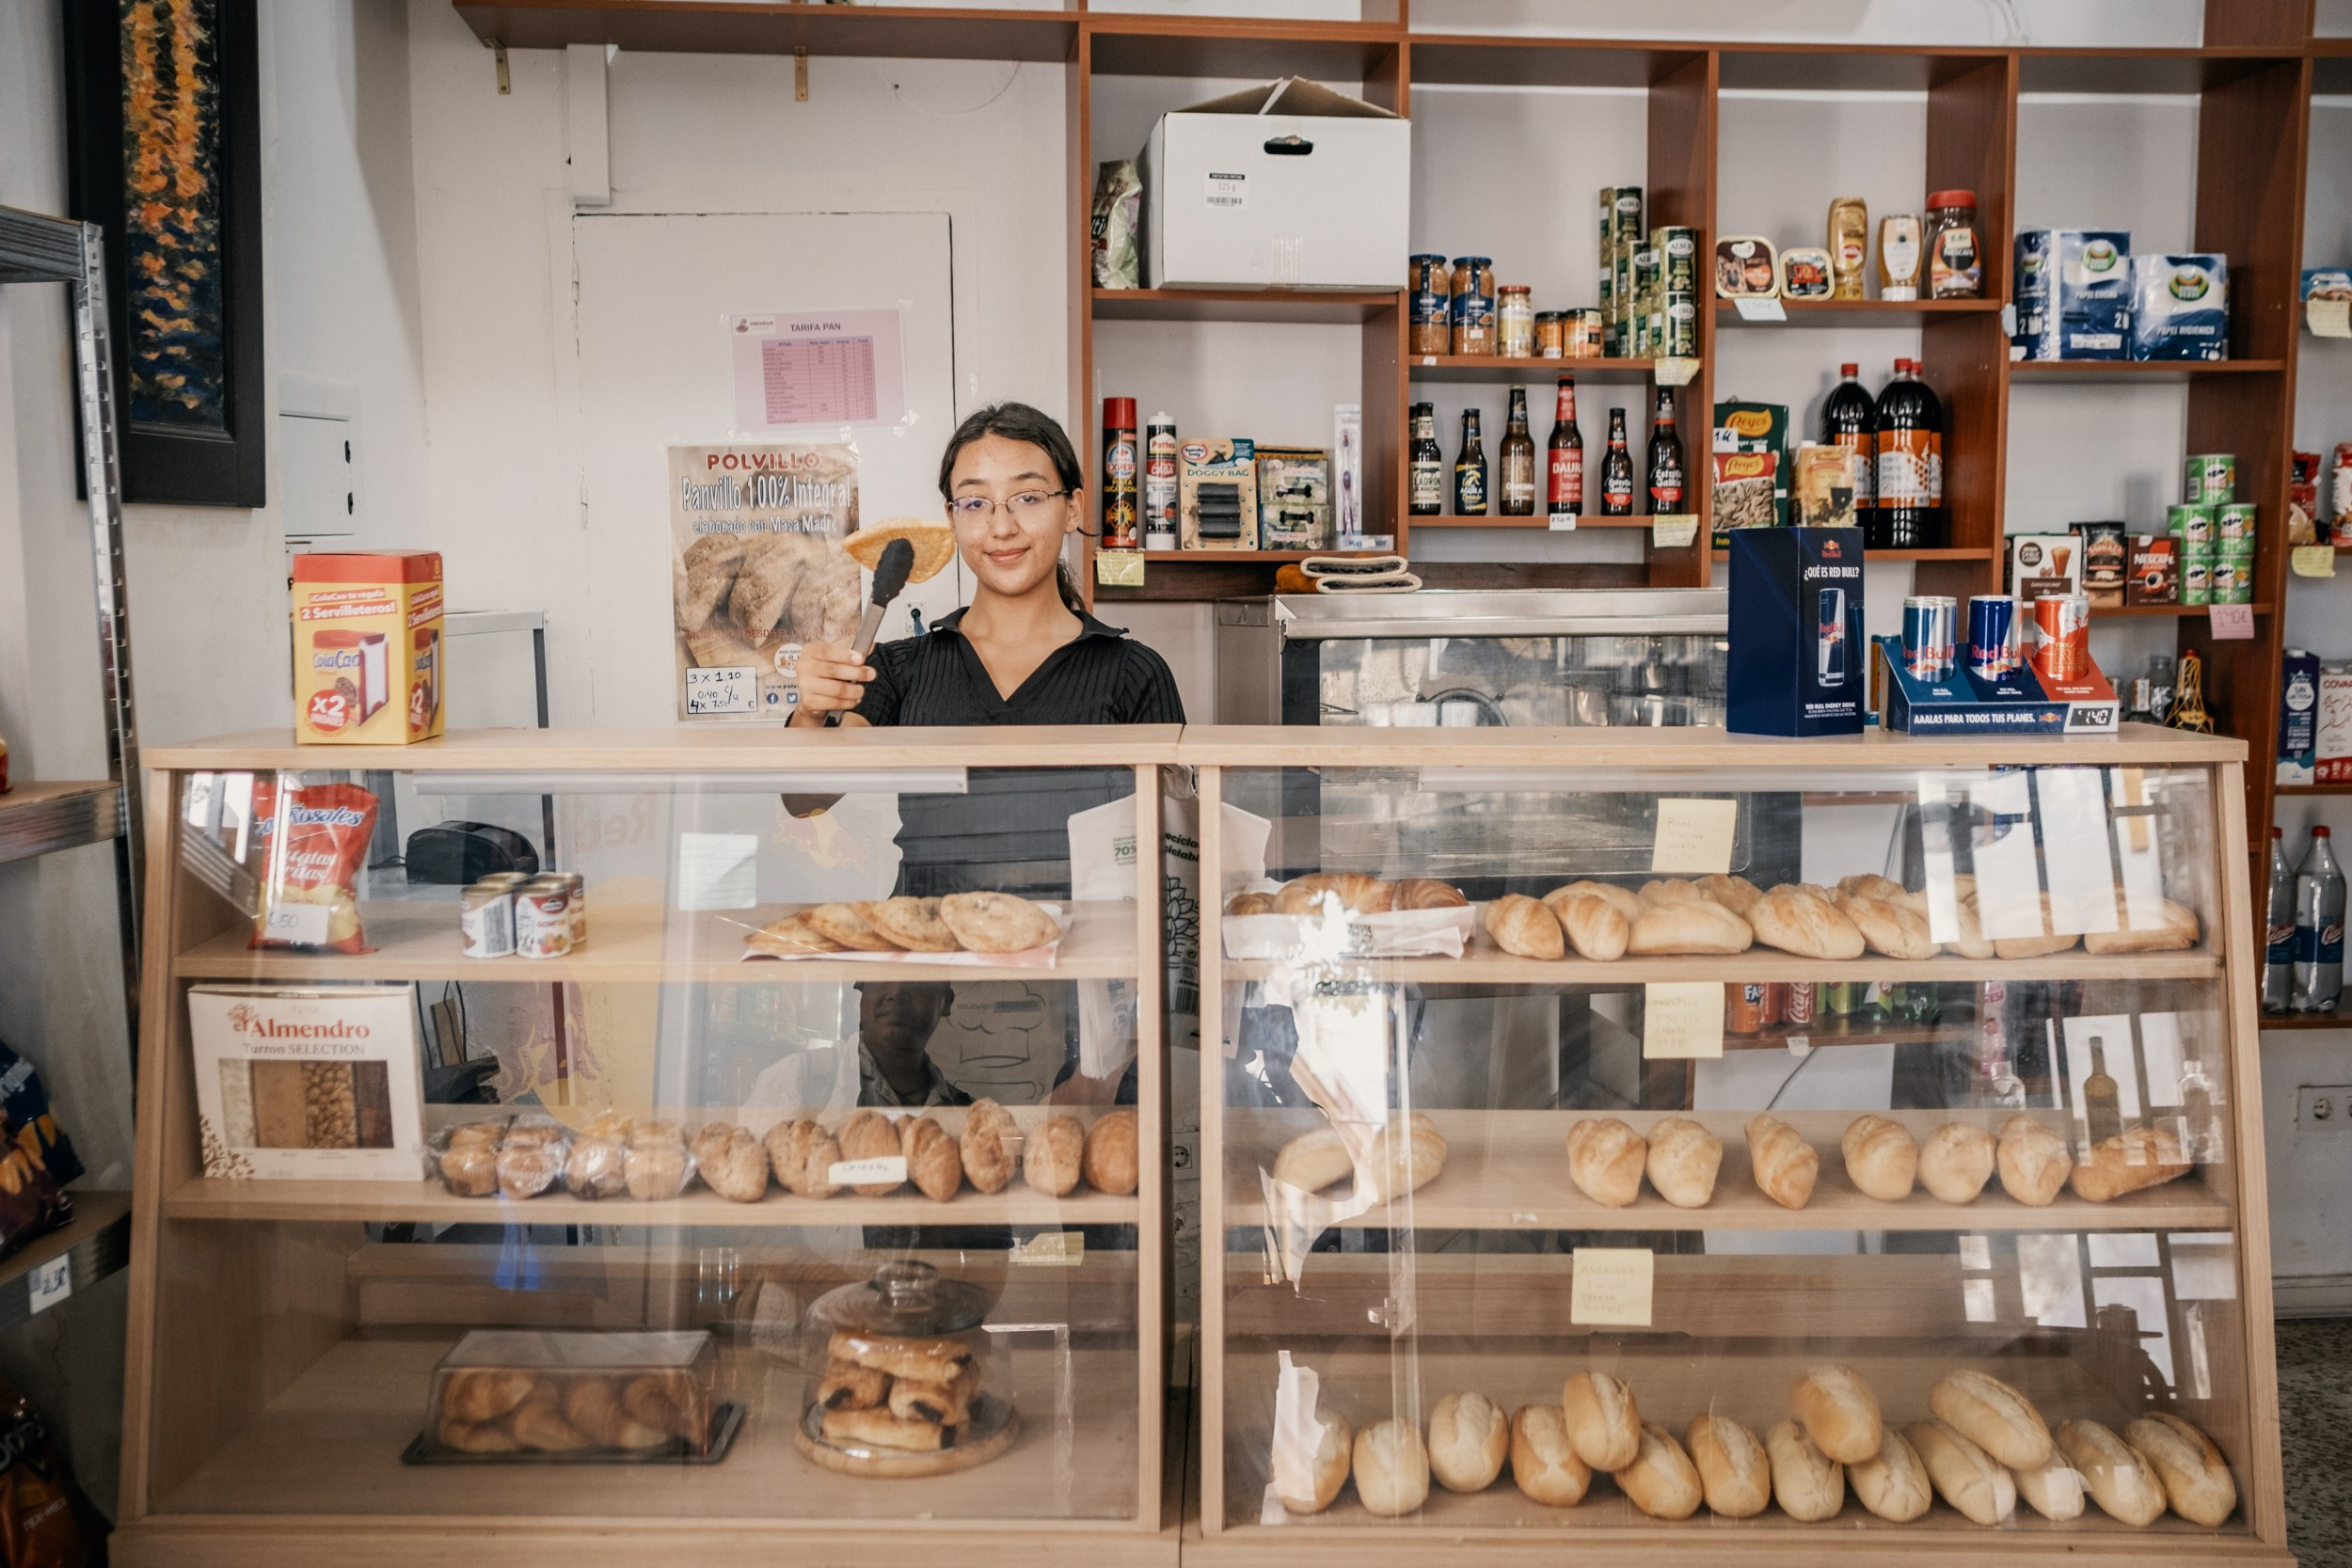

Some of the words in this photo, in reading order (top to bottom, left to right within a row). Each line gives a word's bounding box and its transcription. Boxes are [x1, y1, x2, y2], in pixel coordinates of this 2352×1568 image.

[790, 324, 820, 332] TARIFA
[822, 323, 841, 331] PAN
[707, 452, 820, 470] POLVILLO
[1187, 468, 1225, 477] DOGGY
[1228, 468, 1249, 477] BAG
[682, 475, 741, 512] Panvillo
[747, 474, 790, 510] 100%
[792, 474, 851, 514] Integral
[692, 517, 746, 534] elaborado
[747, 520, 767, 533] con
[769, 515, 800, 532] Masa
[801, 515, 837, 532] Madre
[1804, 564, 1820, 581] ¿QUÉ
[1820, 568, 1828, 578] ES
[1829, 567, 1841, 578] RED
[1841, 566, 1860, 578] BULL?
[301, 609, 310, 620] 2
[312, 602, 396, 618] Servilleteros!
[1971, 644, 1999, 659] Red
[312, 694, 346, 718] x2
[1914, 714, 1944, 724] AAALAS
[1944, 714, 1965, 723] PARA
[1965, 713, 1991, 723] TODOS
[1991, 713, 2006, 722] TUS
[2006, 713, 2036, 722] PLANES.
[289, 806, 365, 827] Rosales
[957, 1002, 994, 1011] WhatsApp
[232, 1019, 249, 1033] el
[249, 1018, 371, 1039] Almendro
[288, 1042, 366, 1055] SELECTION
